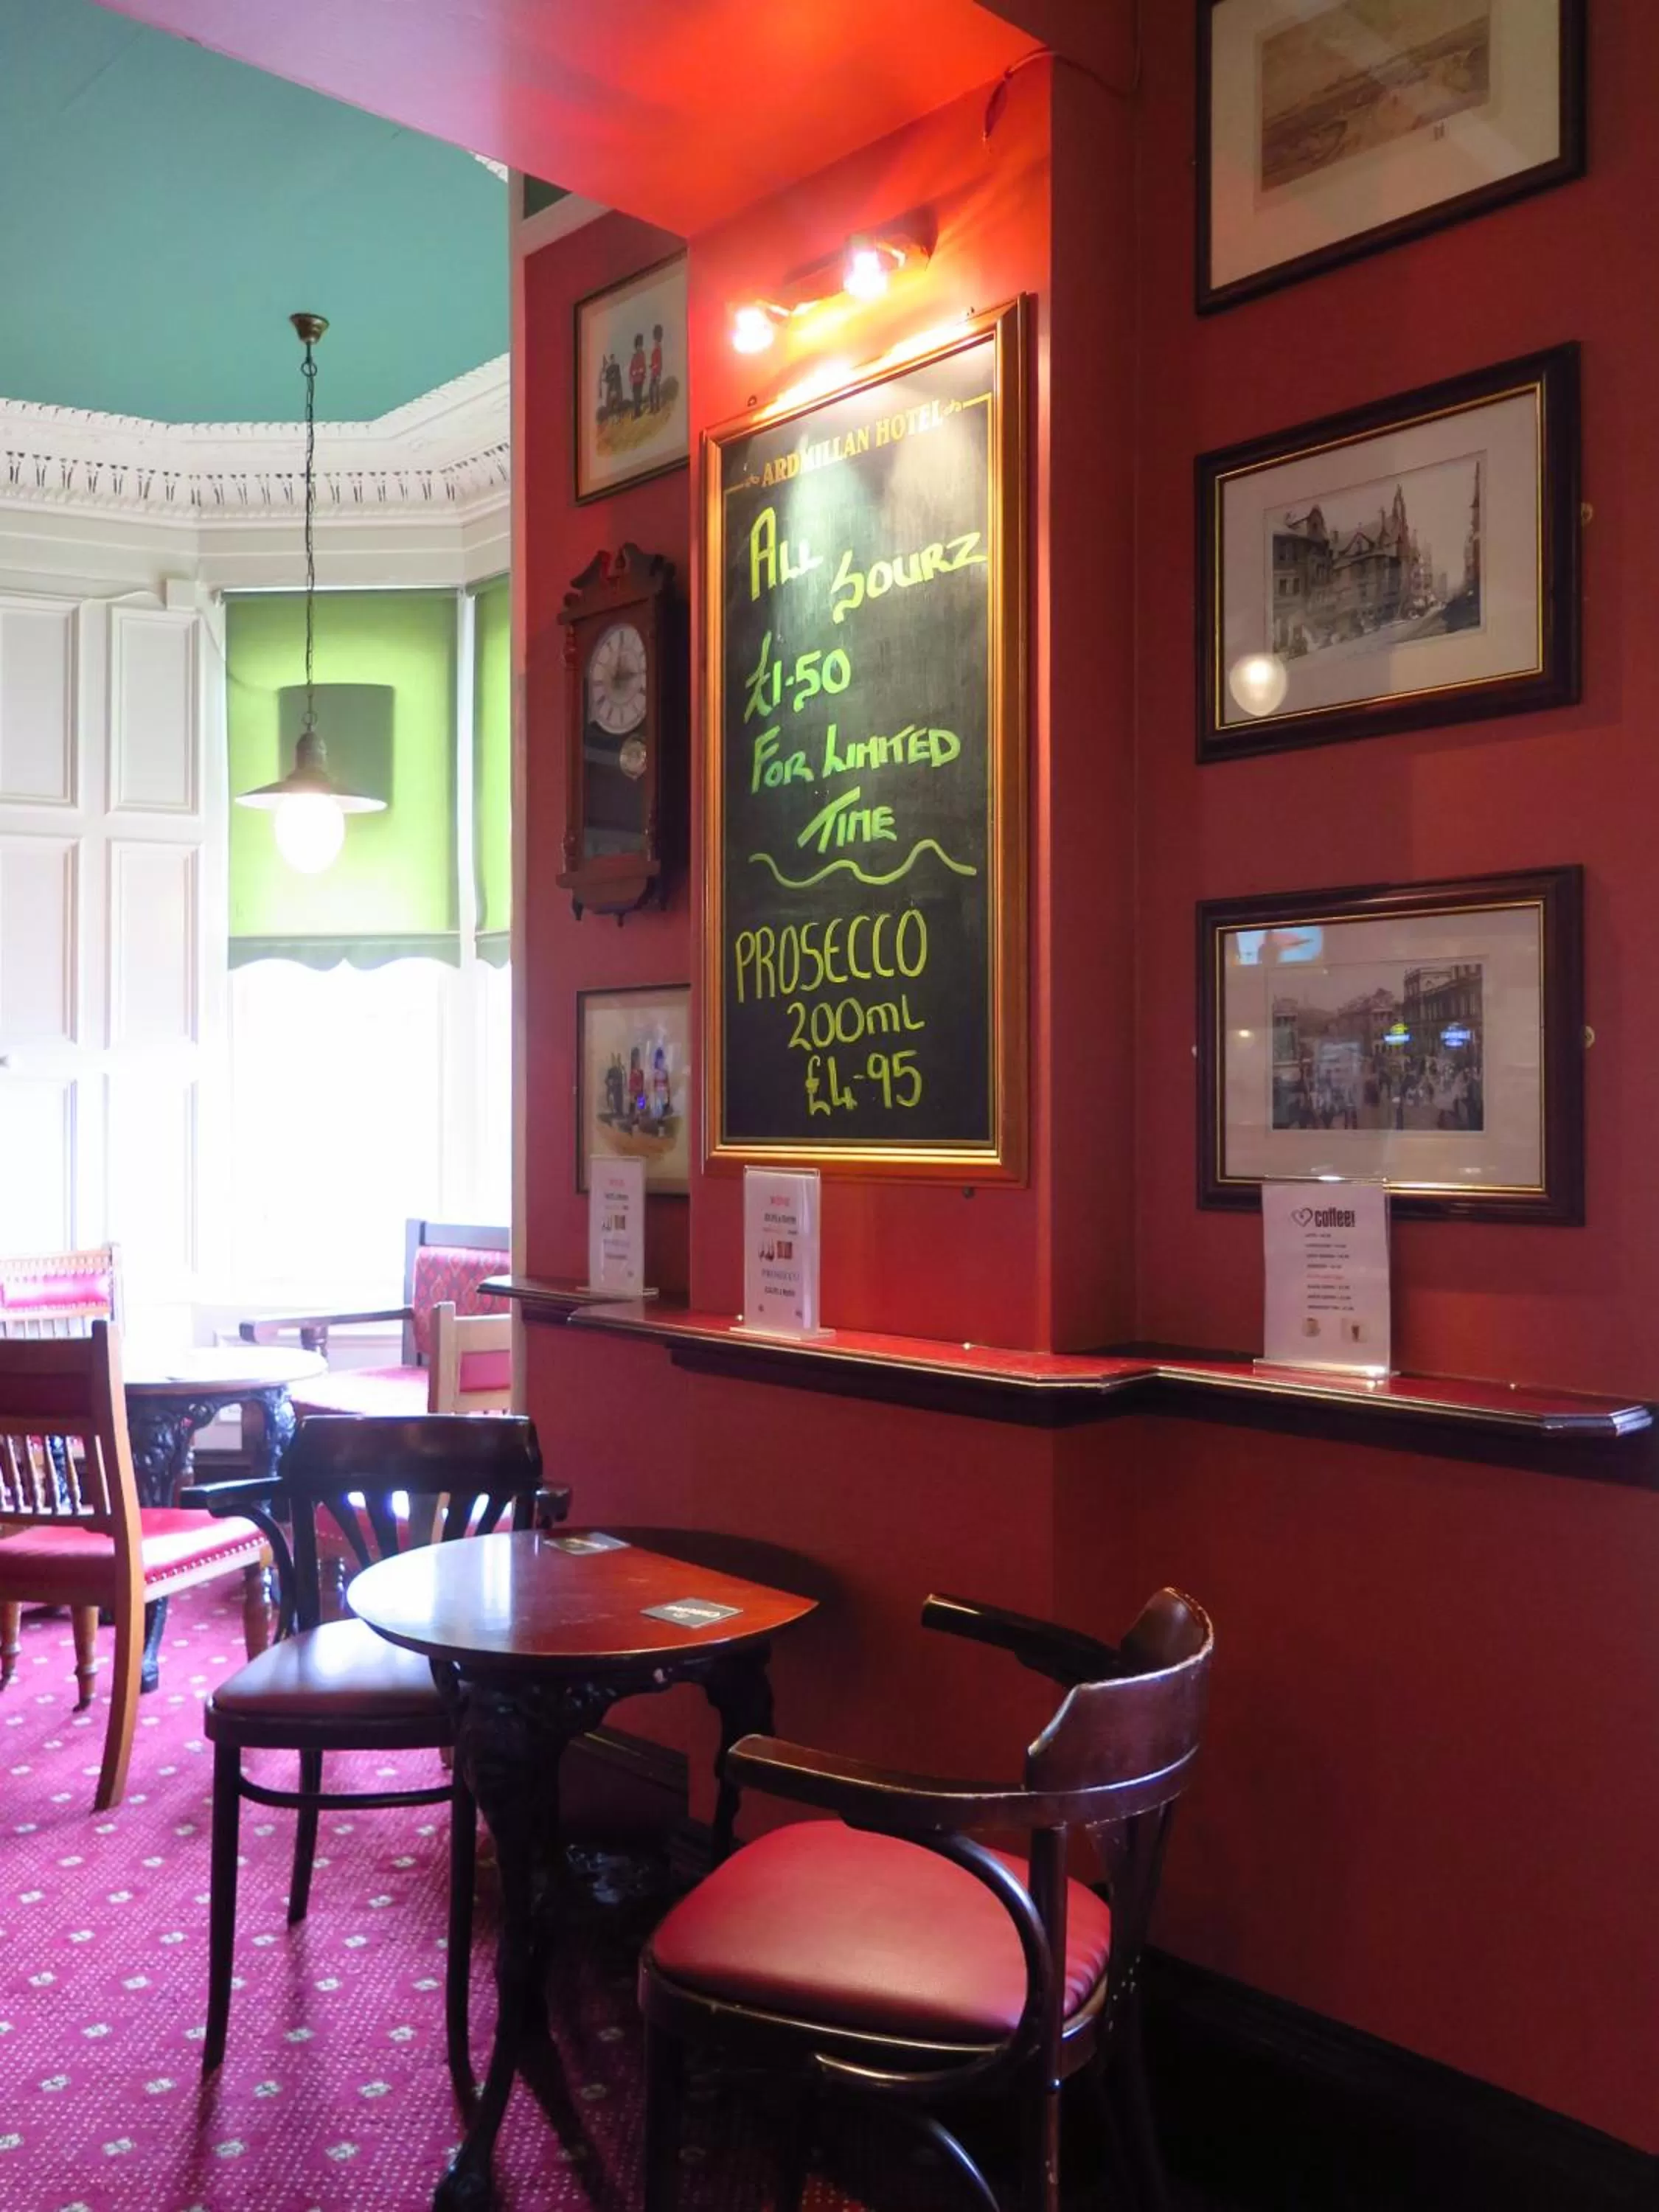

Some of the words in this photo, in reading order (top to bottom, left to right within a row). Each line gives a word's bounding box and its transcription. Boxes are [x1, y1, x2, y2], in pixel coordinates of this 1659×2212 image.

[762, 425, 870, 487] ARDMILLAN
[875, 400, 945, 448] HOTEL
[749, 507, 824, 602] ALL
[830, 532, 990, 625] SOURZ
[751, 725, 814, 794] FOR
[823, 723, 961, 779] LIMITED
[797, 785, 897, 854] TIME
[735, 908, 928, 1004] PROSECCO
